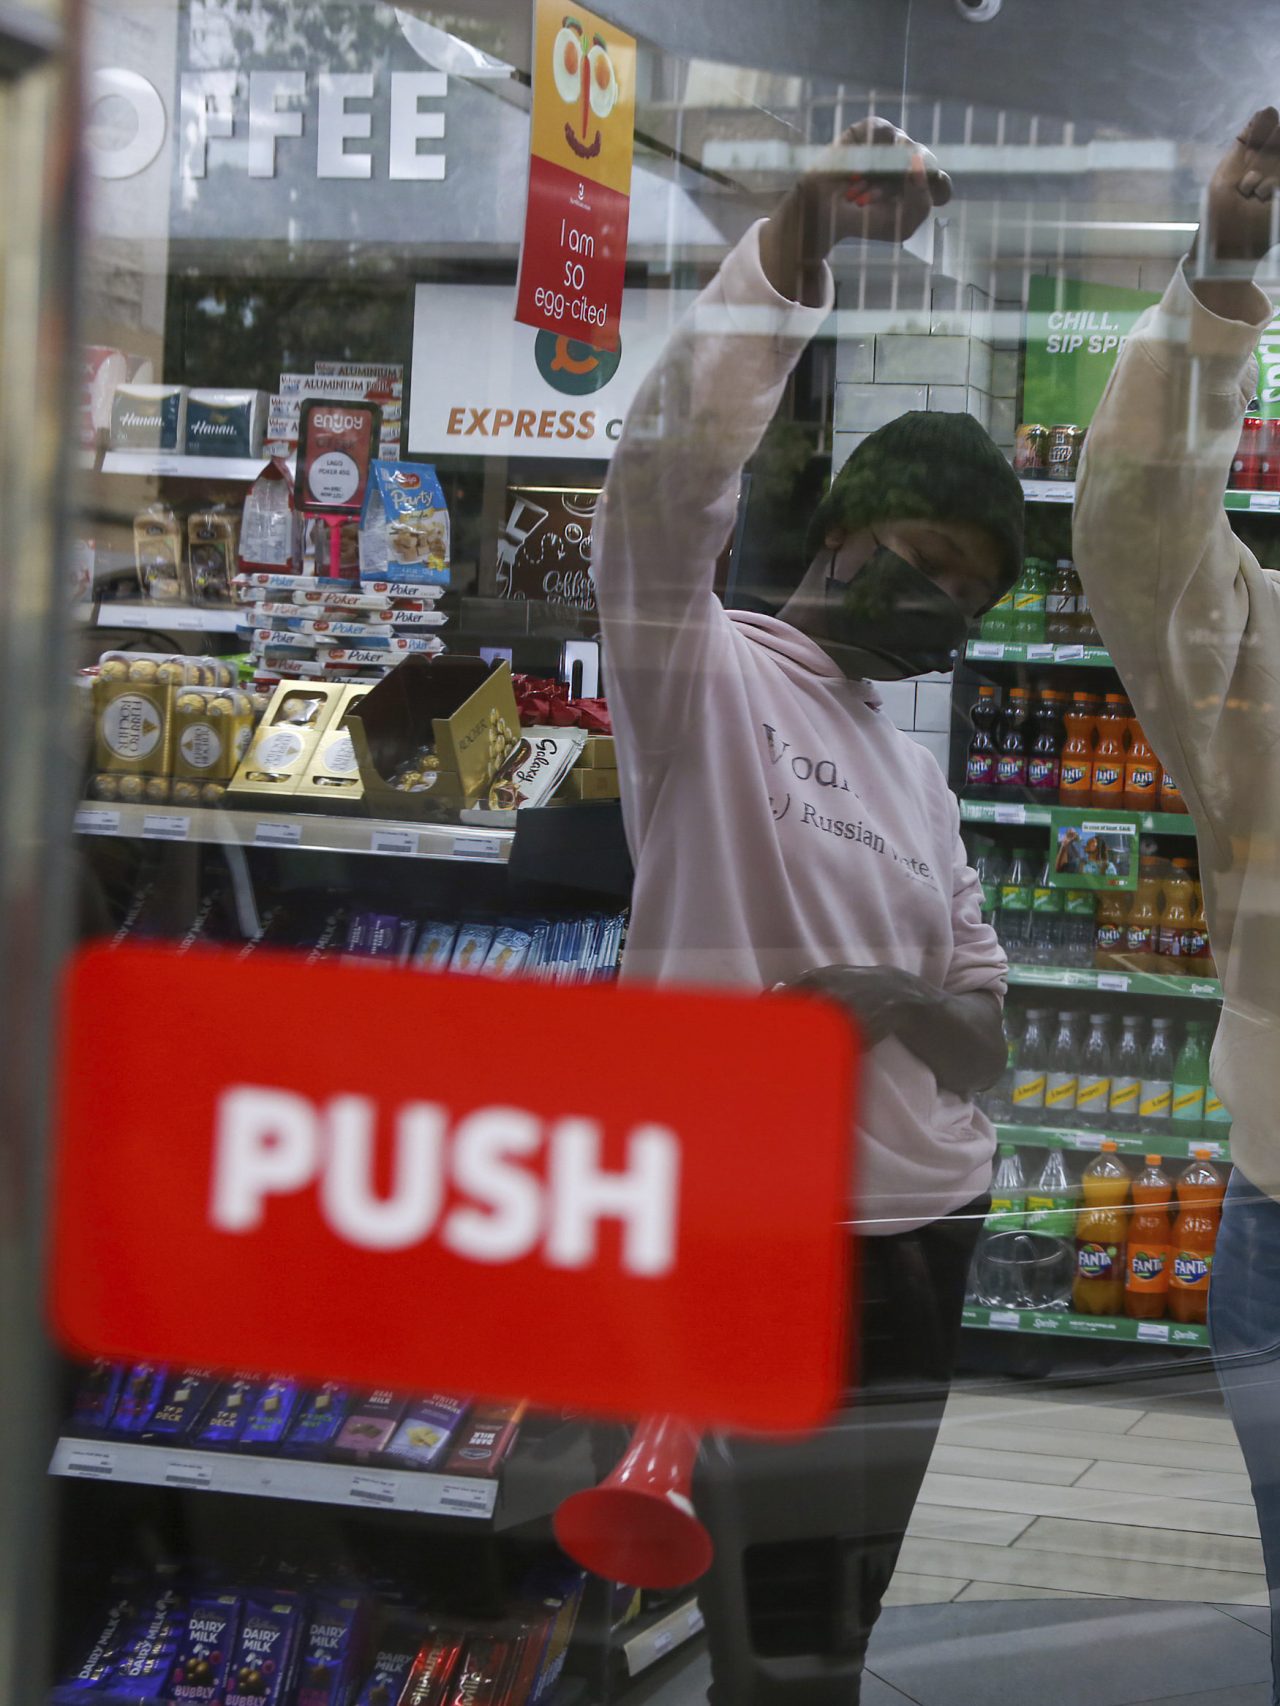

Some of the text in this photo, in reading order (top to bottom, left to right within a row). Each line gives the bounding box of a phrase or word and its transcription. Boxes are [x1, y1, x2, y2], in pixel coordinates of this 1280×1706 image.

[86, 69, 448, 180] OFFEE
[560, 218, 595, 258] I am
[534, 286, 608, 327] egg-cited
[1047, 311, 1119, 331] CHILL.
[1046, 334, 1084, 353] SIP
[338, 364, 398, 378] ALUMINIUM
[304, 378, 363, 392] ALUMINIUM
[313, 413, 363, 434] enjoy
[446, 407, 596, 440] EXPRESS
[390, 488, 434, 510] Party
[389, 583, 419, 596] Poker
[324, 593, 361, 605] Poker
[394, 612, 423, 623] Poker
[331, 623, 366, 634] Poker
[271, 633, 295, 644] Poker
[347, 651, 384, 662] Poker
[516, 737, 558, 784] Galaxy
[800, 800, 886, 854] Russian
[208, 1082, 683, 1281] PUSH
[1079, 1250, 1112, 1267] FANTA
[1131, 1257, 1163, 1274] FANTA
[1174, 1258, 1210, 1275] FANTA
[368, 1396, 392, 1405] MILK
[155, 1412, 182, 1423] DECK
[210, 1418, 237, 1429] DECK
[189, 1618, 227, 1632] DAIRY
[309, 1623, 348, 1637] DAIRY
[189, 1630, 218, 1644] MILK
[242, 1627, 281, 1642] DAIRY
[309, 1635, 340, 1649] MILK
[78, 1616, 120, 1680] DAIRY MILK
[129, 1609, 168, 1677] DAIRY MILK
[242, 1638, 272, 1653] MILK
[375, 1651, 414, 1665] DAIRY
[374, 1661, 406, 1674] MILK
[174, 1684, 215, 1700] BUBBLY
